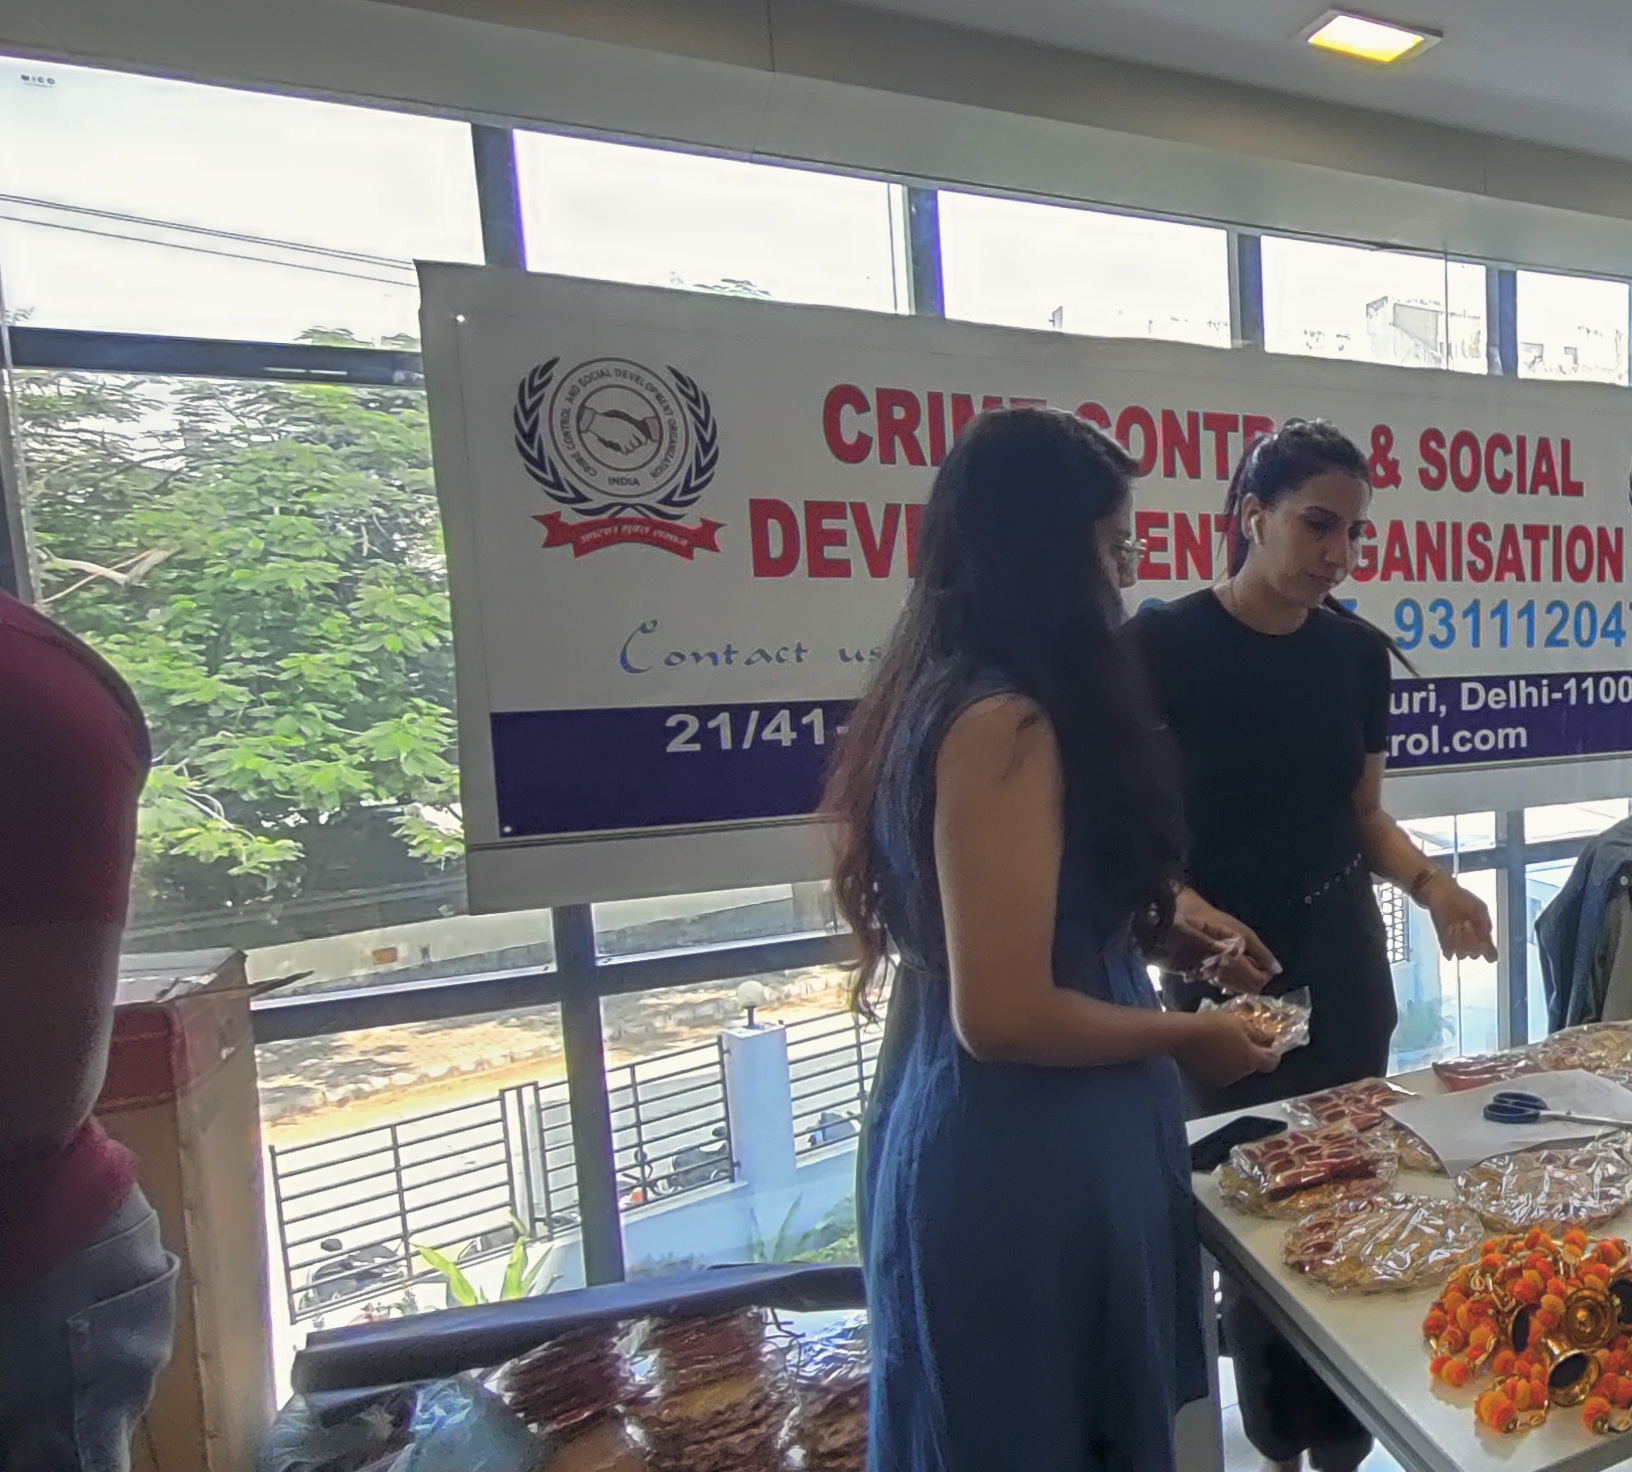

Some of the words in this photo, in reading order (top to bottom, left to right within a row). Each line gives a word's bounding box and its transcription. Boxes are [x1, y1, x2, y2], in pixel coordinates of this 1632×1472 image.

[565, 384, 581, 405] AND
[1368, 424, 1402, 490] &
[1418, 427, 1585, 497] SOCIAL
[608, 476, 640, 487] INDIA
[1350, 519, 1624, 584] GANISATION
[620, 619, 809, 674] Contact
[1389, 683, 1447, 718] uri,
[1385, 725, 1528, 757] rol.com
